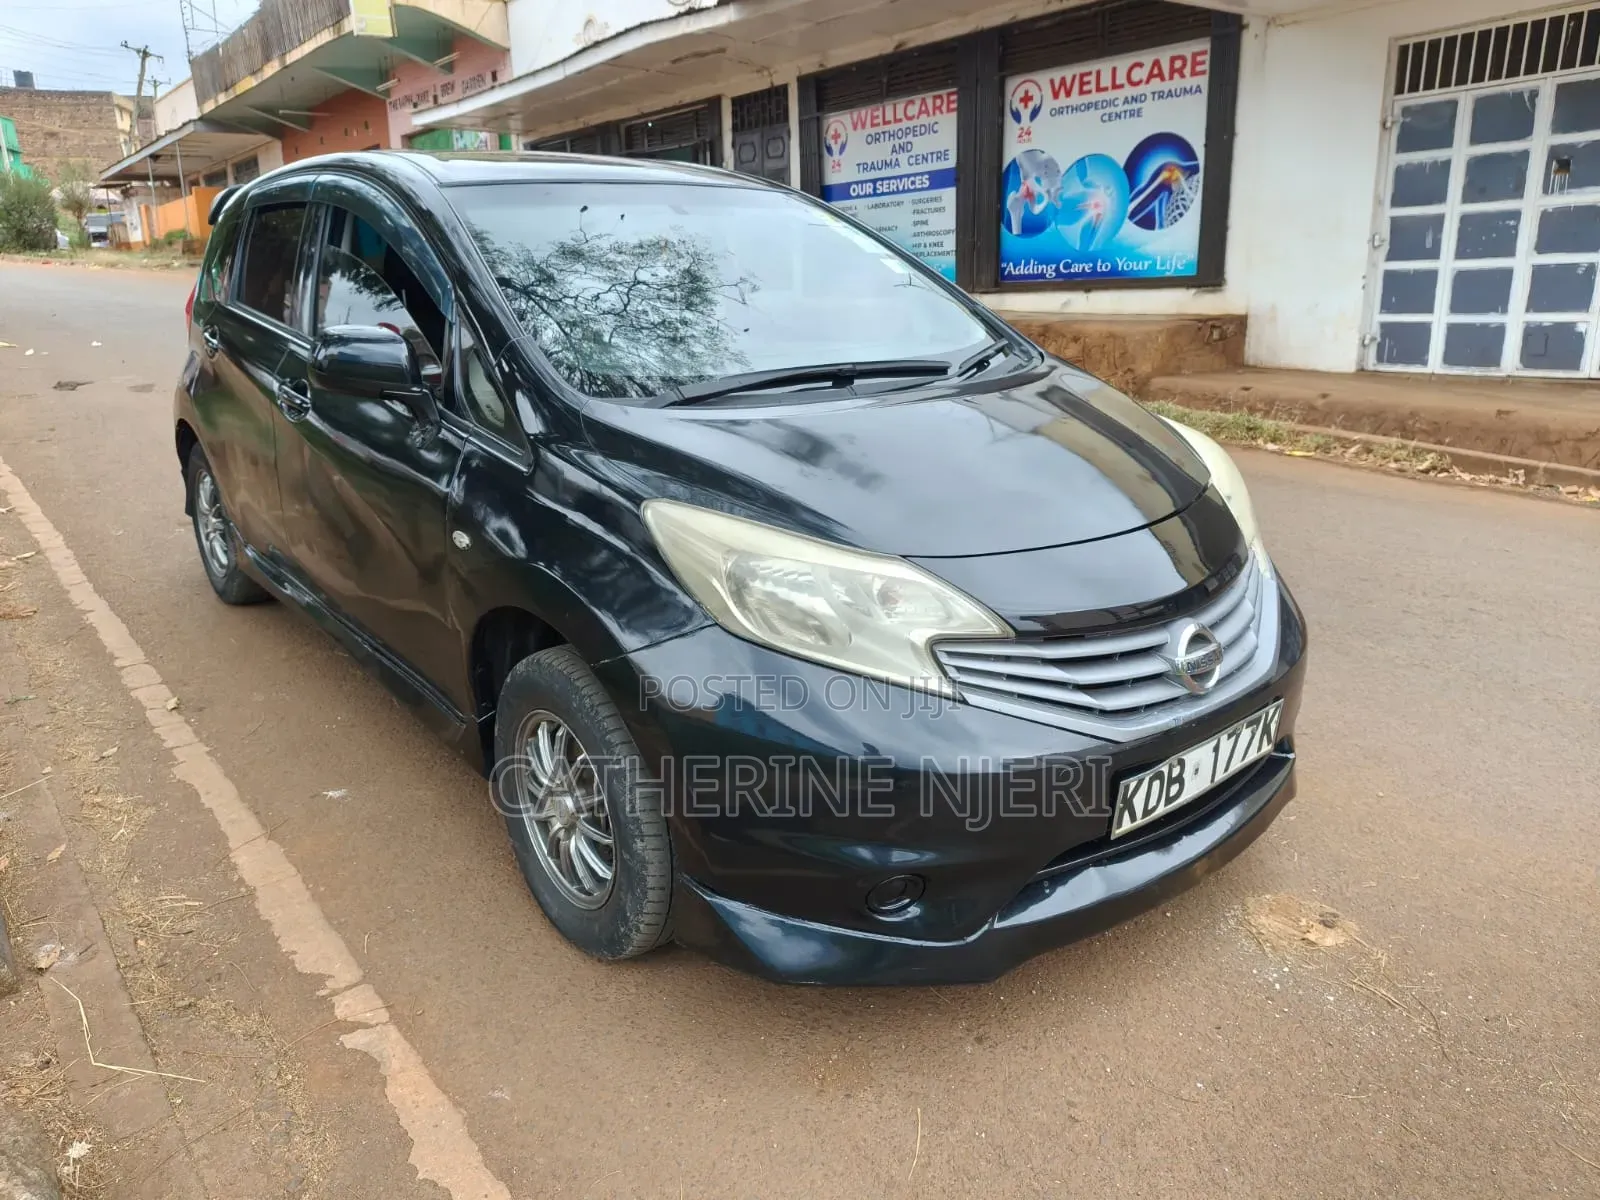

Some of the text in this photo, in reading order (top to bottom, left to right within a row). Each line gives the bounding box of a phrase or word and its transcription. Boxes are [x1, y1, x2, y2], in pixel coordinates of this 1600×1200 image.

[1049, 49, 1209, 100] WELLCARE
[850, 91, 957, 132] WELLCARE
[1049, 84, 1203, 117] ORTHOPEDIC AND TRAUMA
[1100, 107, 1143, 123] CENTRE
[865, 122, 939, 145] ORTHOPEDIC
[1016, 126, 1032, 138] 24
[890, 141, 913, 156] AND
[856, 149, 950, 174] TRAUMA CENTRE
[850, 175, 930, 197] OUR SERVICES
[867, 200, 904, 210] LABORATORY
[912, 206, 946, 215] FRACTURES
[1059, 258, 1093, 273] Care
[1097, 259, 1111, 272] to
[1115, 257, 1151, 271] Your
[1115, 706, 1282, 831] KDB 177K
